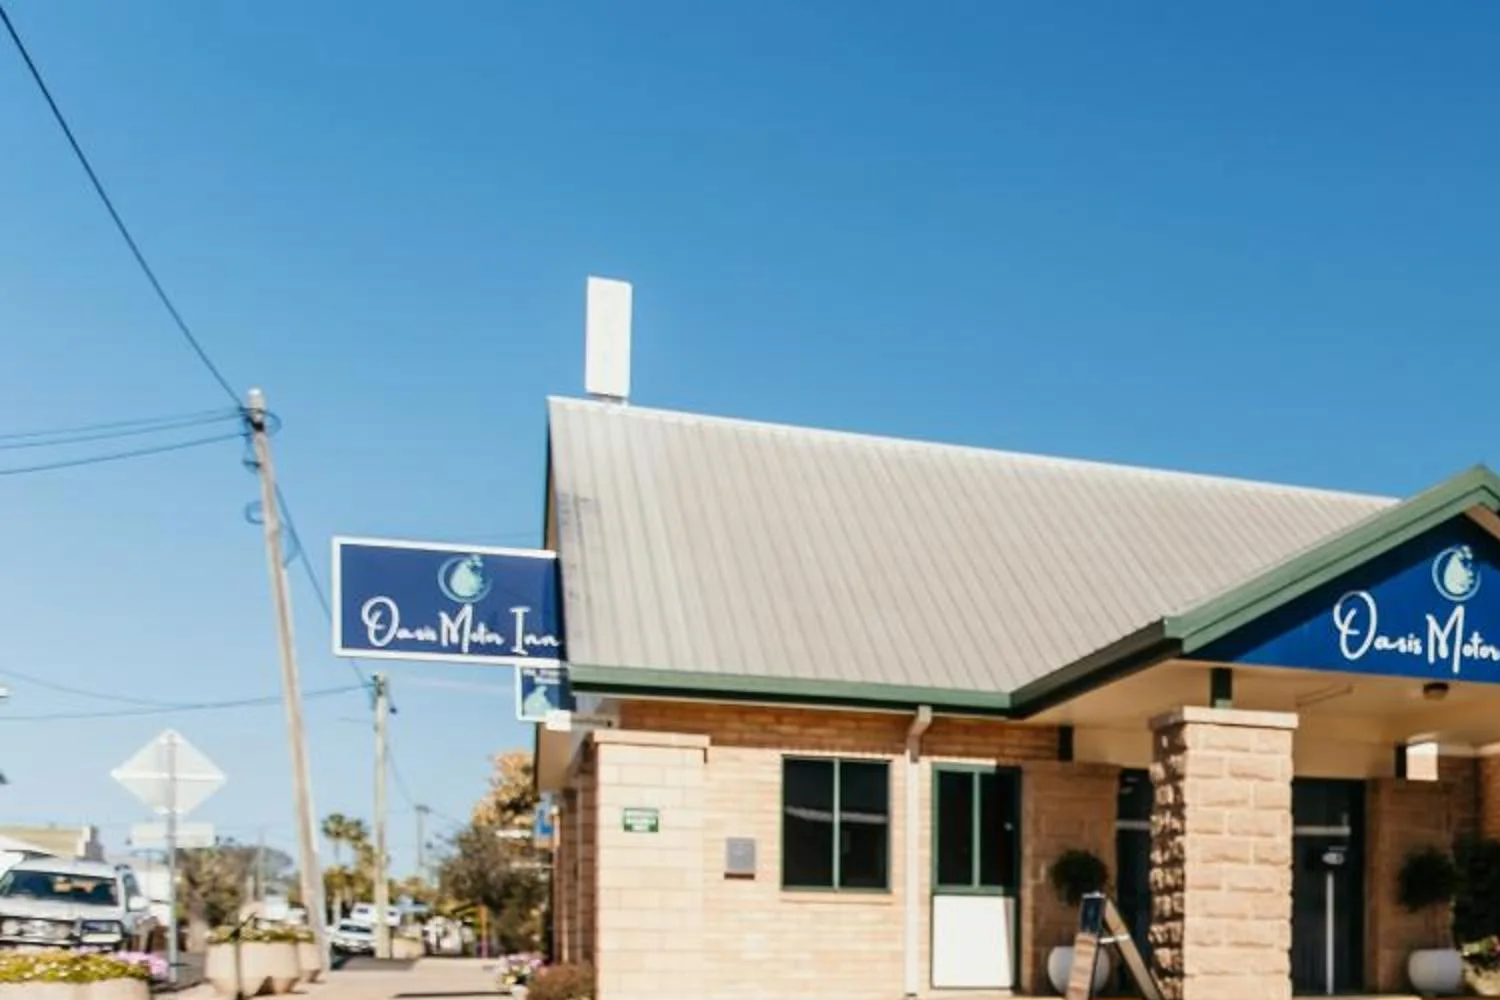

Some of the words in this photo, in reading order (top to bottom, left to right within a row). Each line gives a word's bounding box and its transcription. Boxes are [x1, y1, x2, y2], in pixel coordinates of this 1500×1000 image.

[361, 596, 437, 647] Oasis
[438, 603, 504, 653] Motor
[509, 606, 560, 656] Inn
[1333, 590, 1422, 660] Oasis
